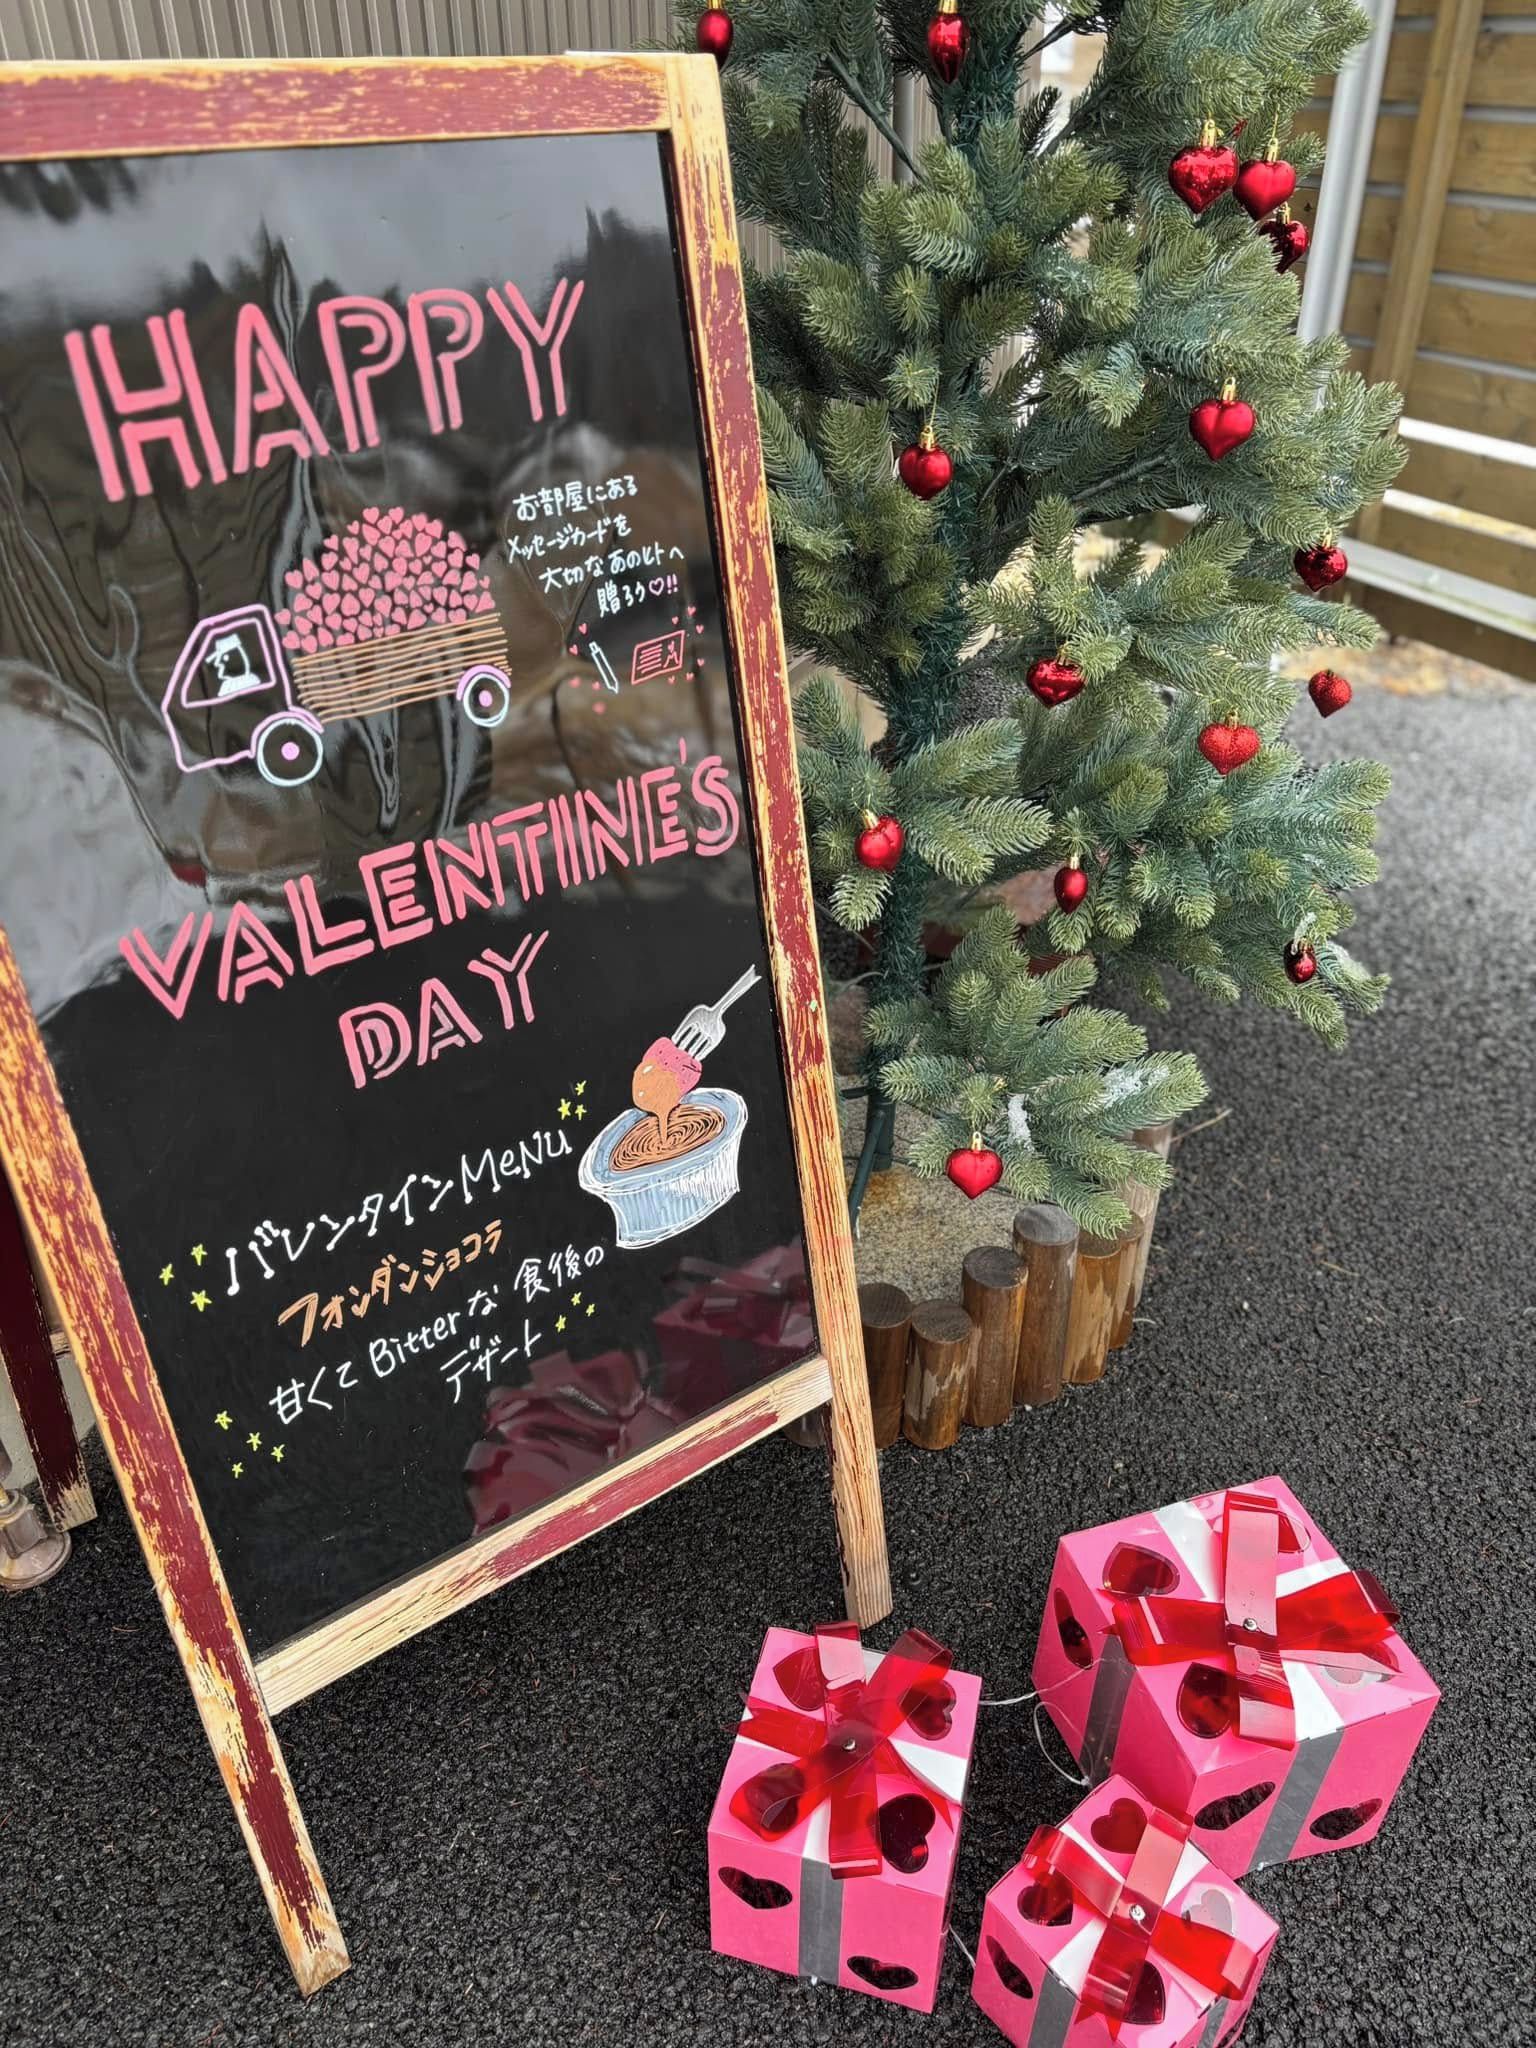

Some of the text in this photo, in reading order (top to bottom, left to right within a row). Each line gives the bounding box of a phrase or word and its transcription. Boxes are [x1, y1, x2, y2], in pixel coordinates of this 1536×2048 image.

[64, 278, 585, 502] HAPPY
[507, 513, 632, 564] メッセージカードを
[512, 474, 638, 521] お部屋にある
[119, 737, 741, 1021] VALENTINE'S
[338, 930, 549, 1089] DAY
[277, 1219, 502, 1348] フォンダンショコラ
[440, 1319, 542, 1403] デザート
